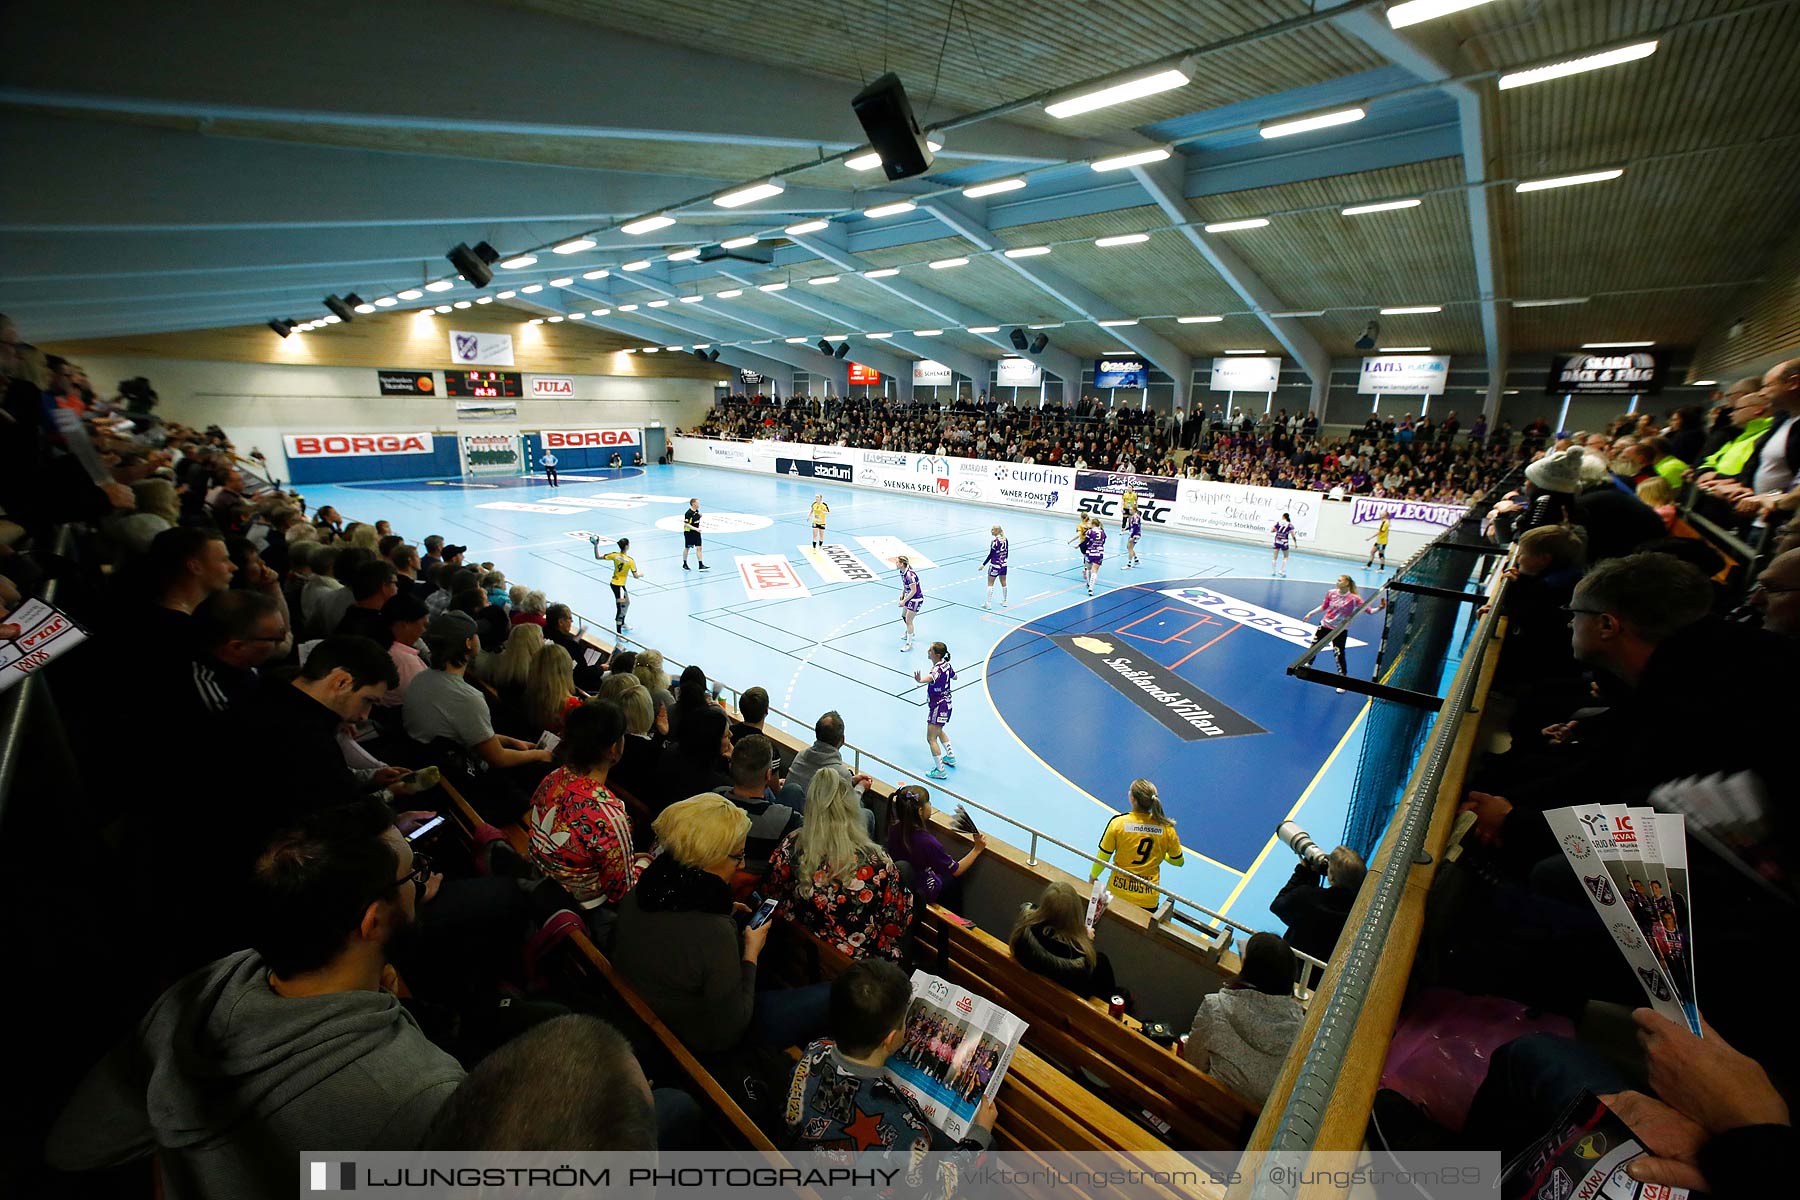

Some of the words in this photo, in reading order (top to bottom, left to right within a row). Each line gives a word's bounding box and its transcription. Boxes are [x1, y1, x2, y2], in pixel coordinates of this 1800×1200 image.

[533, 381, 572, 393] JULA
[295, 436, 425, 455] BORGA
[547, 431, 634, 447] BORGA
[814, 464, 851, 479] stadium
[1012, 469, 1069, 486] eurofins
[883, 479, 916, 491] SVENSKA
[917, 483, 936, 494] SPEL
[1077, 494, 1119, 516] stc
[1233, 522, 1266, 532] Stockholm
[22, 617, 64, 646] JULA
[12, 649, 50, 674] SKARA
[1102, 657, 1225, 736] SmålandsVillan
[1131, 837, 1155, 865] 9
